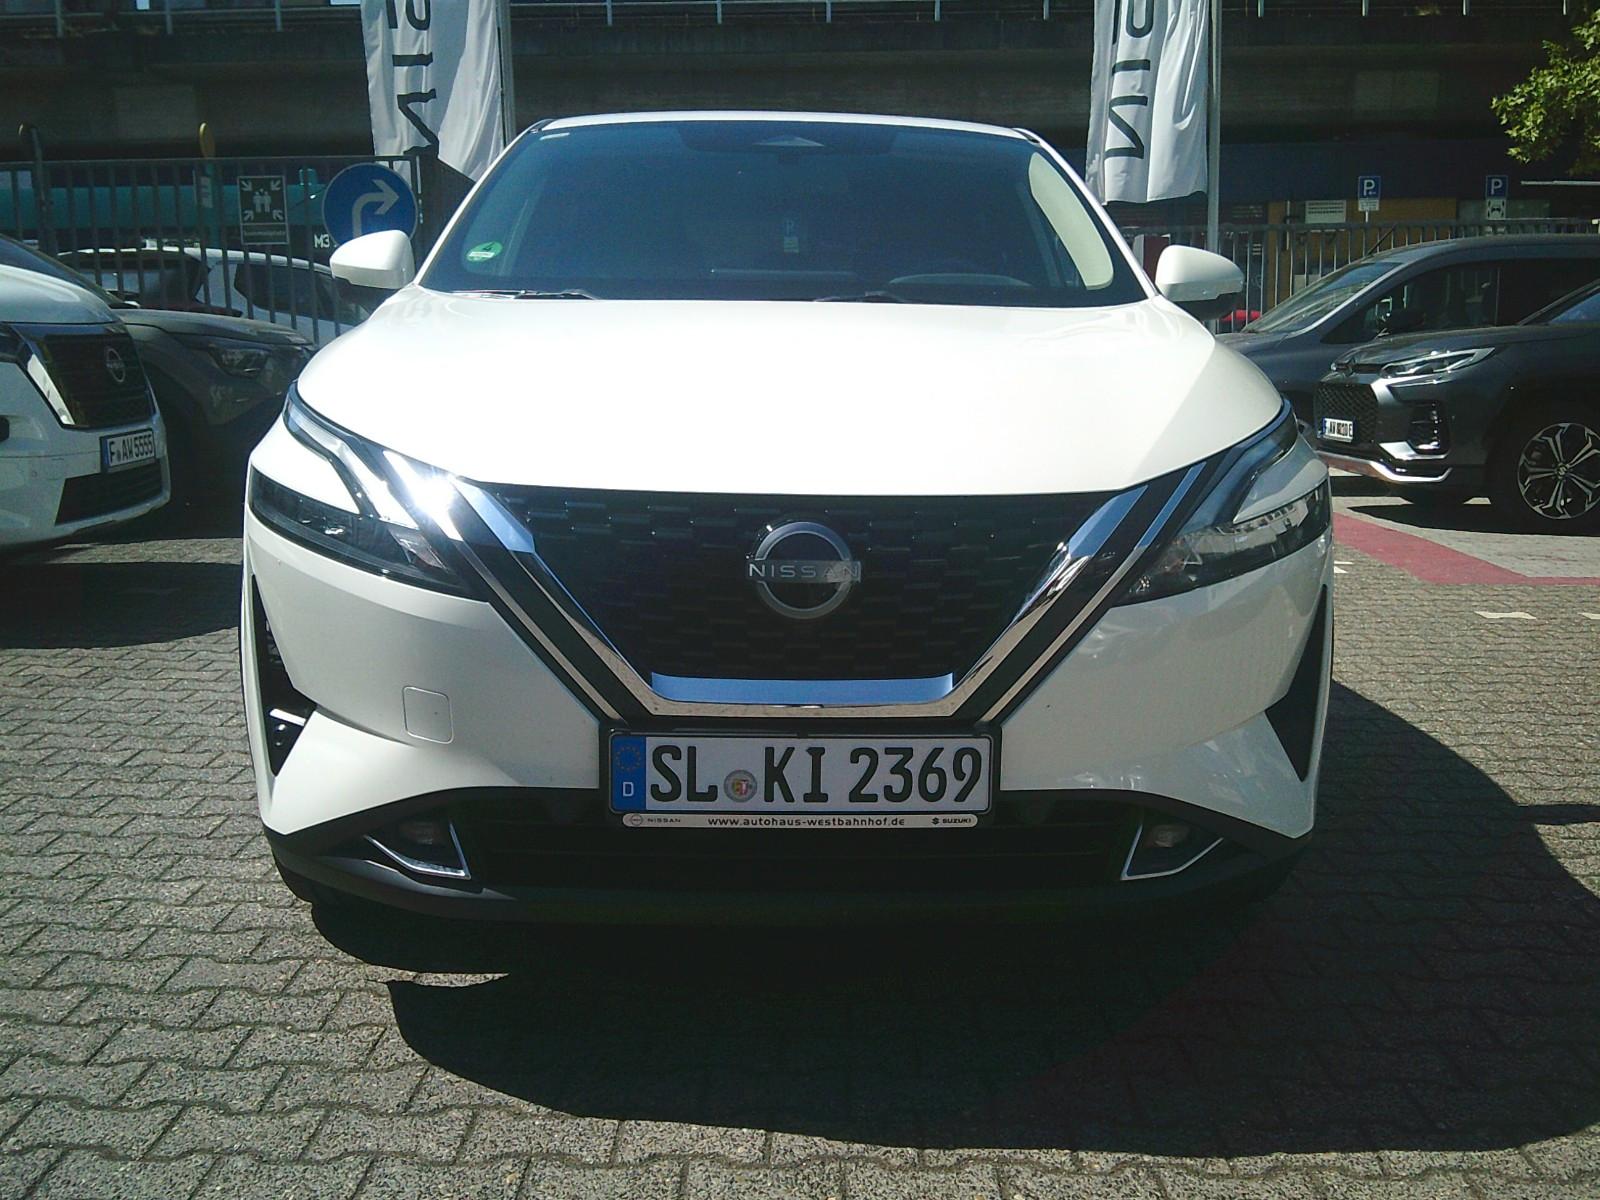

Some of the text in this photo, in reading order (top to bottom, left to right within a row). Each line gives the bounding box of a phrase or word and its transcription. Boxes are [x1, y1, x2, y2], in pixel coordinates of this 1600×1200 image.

[1363, 179, 1375, 196] P
[1491, 178, 1503, 195] P
[109, 441, 116, 464] F
[134, 434, 153, 458] 5555
[749, 562, 860, 579] NISSAN
[650, 744, 982, 803] SL KI 2369
[622, 782, 634, 797] D
[707, 815, 905, 827] www.autohaus-westbahnhof.de
